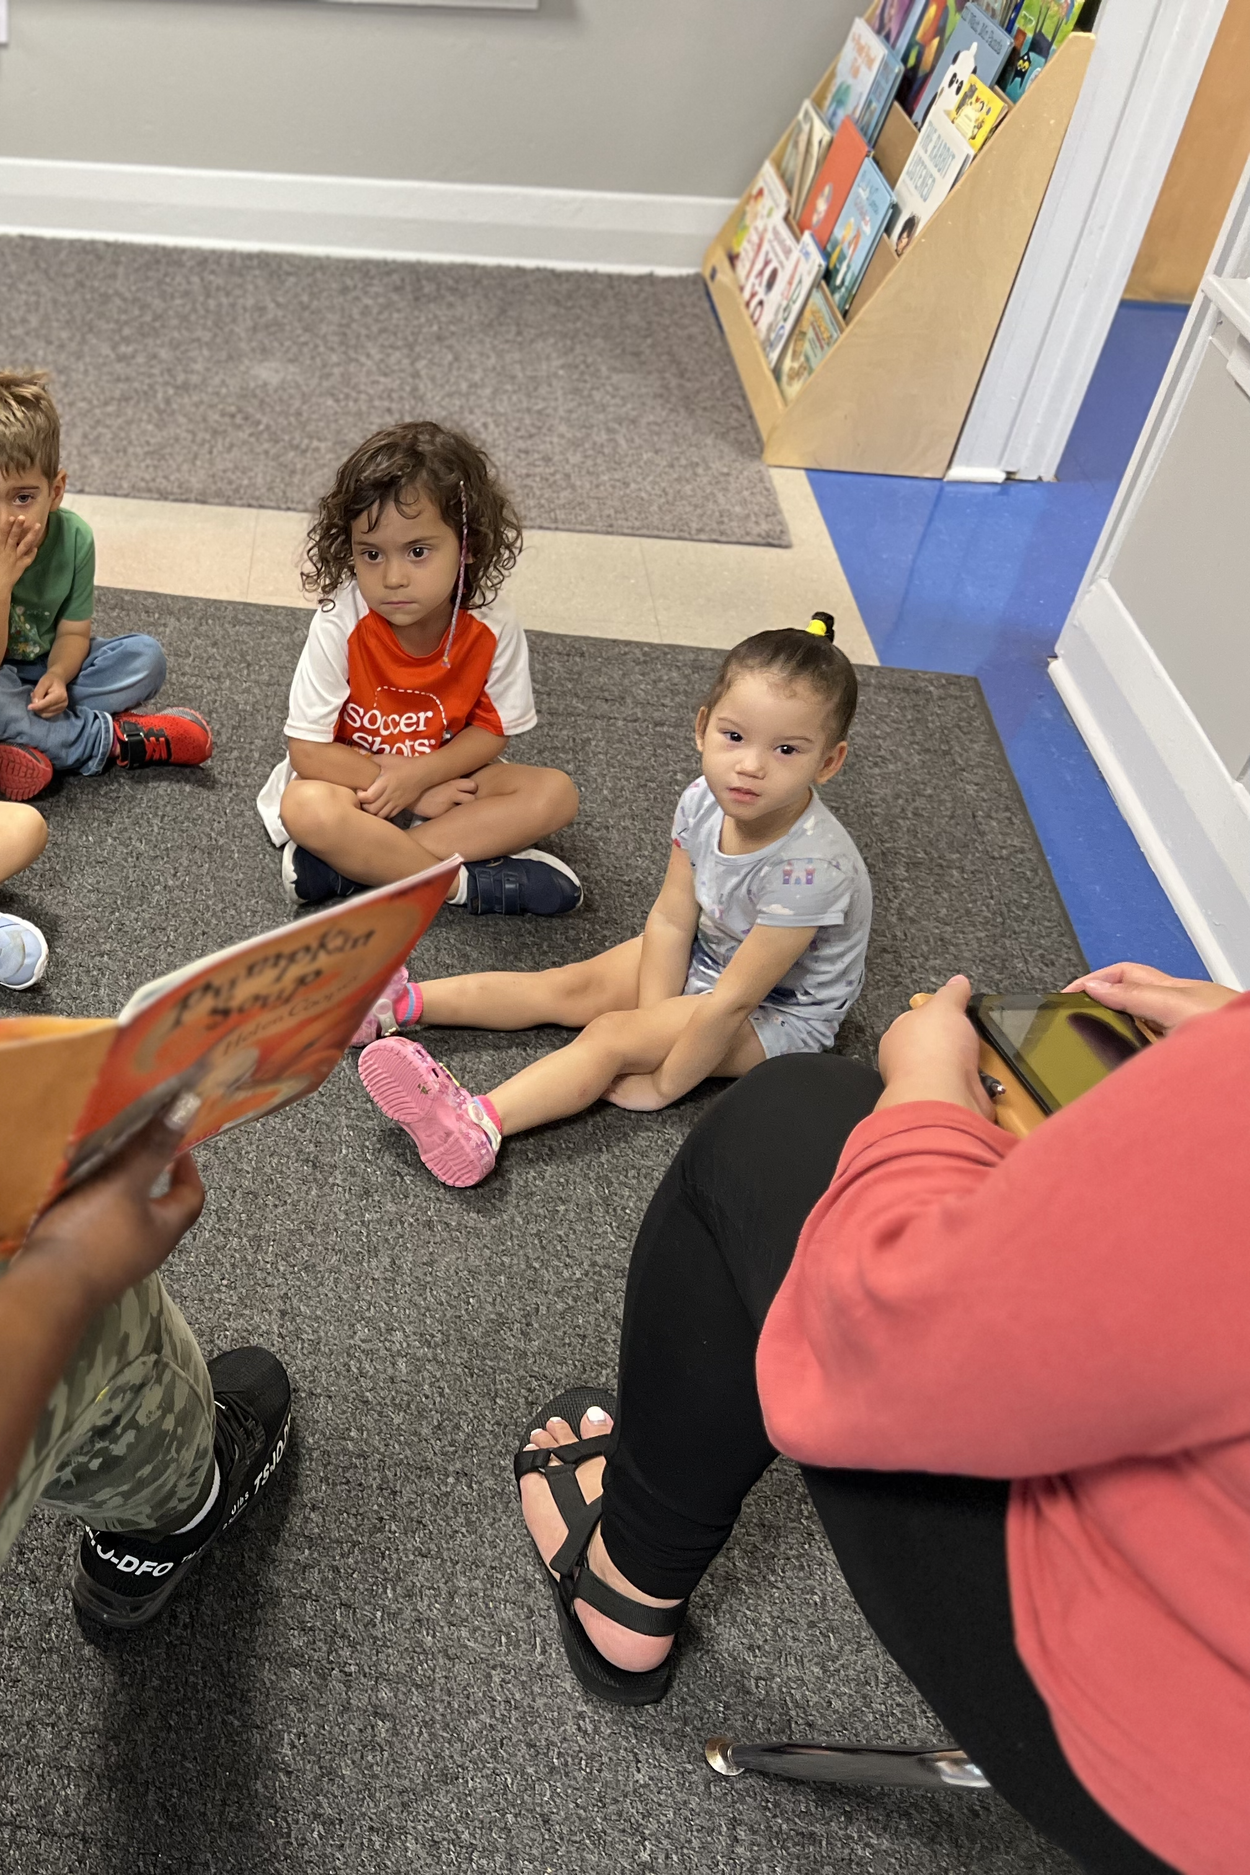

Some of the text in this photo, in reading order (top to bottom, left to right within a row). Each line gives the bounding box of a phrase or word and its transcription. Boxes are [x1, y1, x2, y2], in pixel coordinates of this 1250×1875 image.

[906, 150, 936, 203] LISTENED
[929, 133, 956, 179] RABBIT
[343, 702, 434, 736] Soccer
[172, 927, 376, 1029] Pumpkin
[204, 968, 324, 1031] Soup
[222, 1013, 284, 1057] Helen
